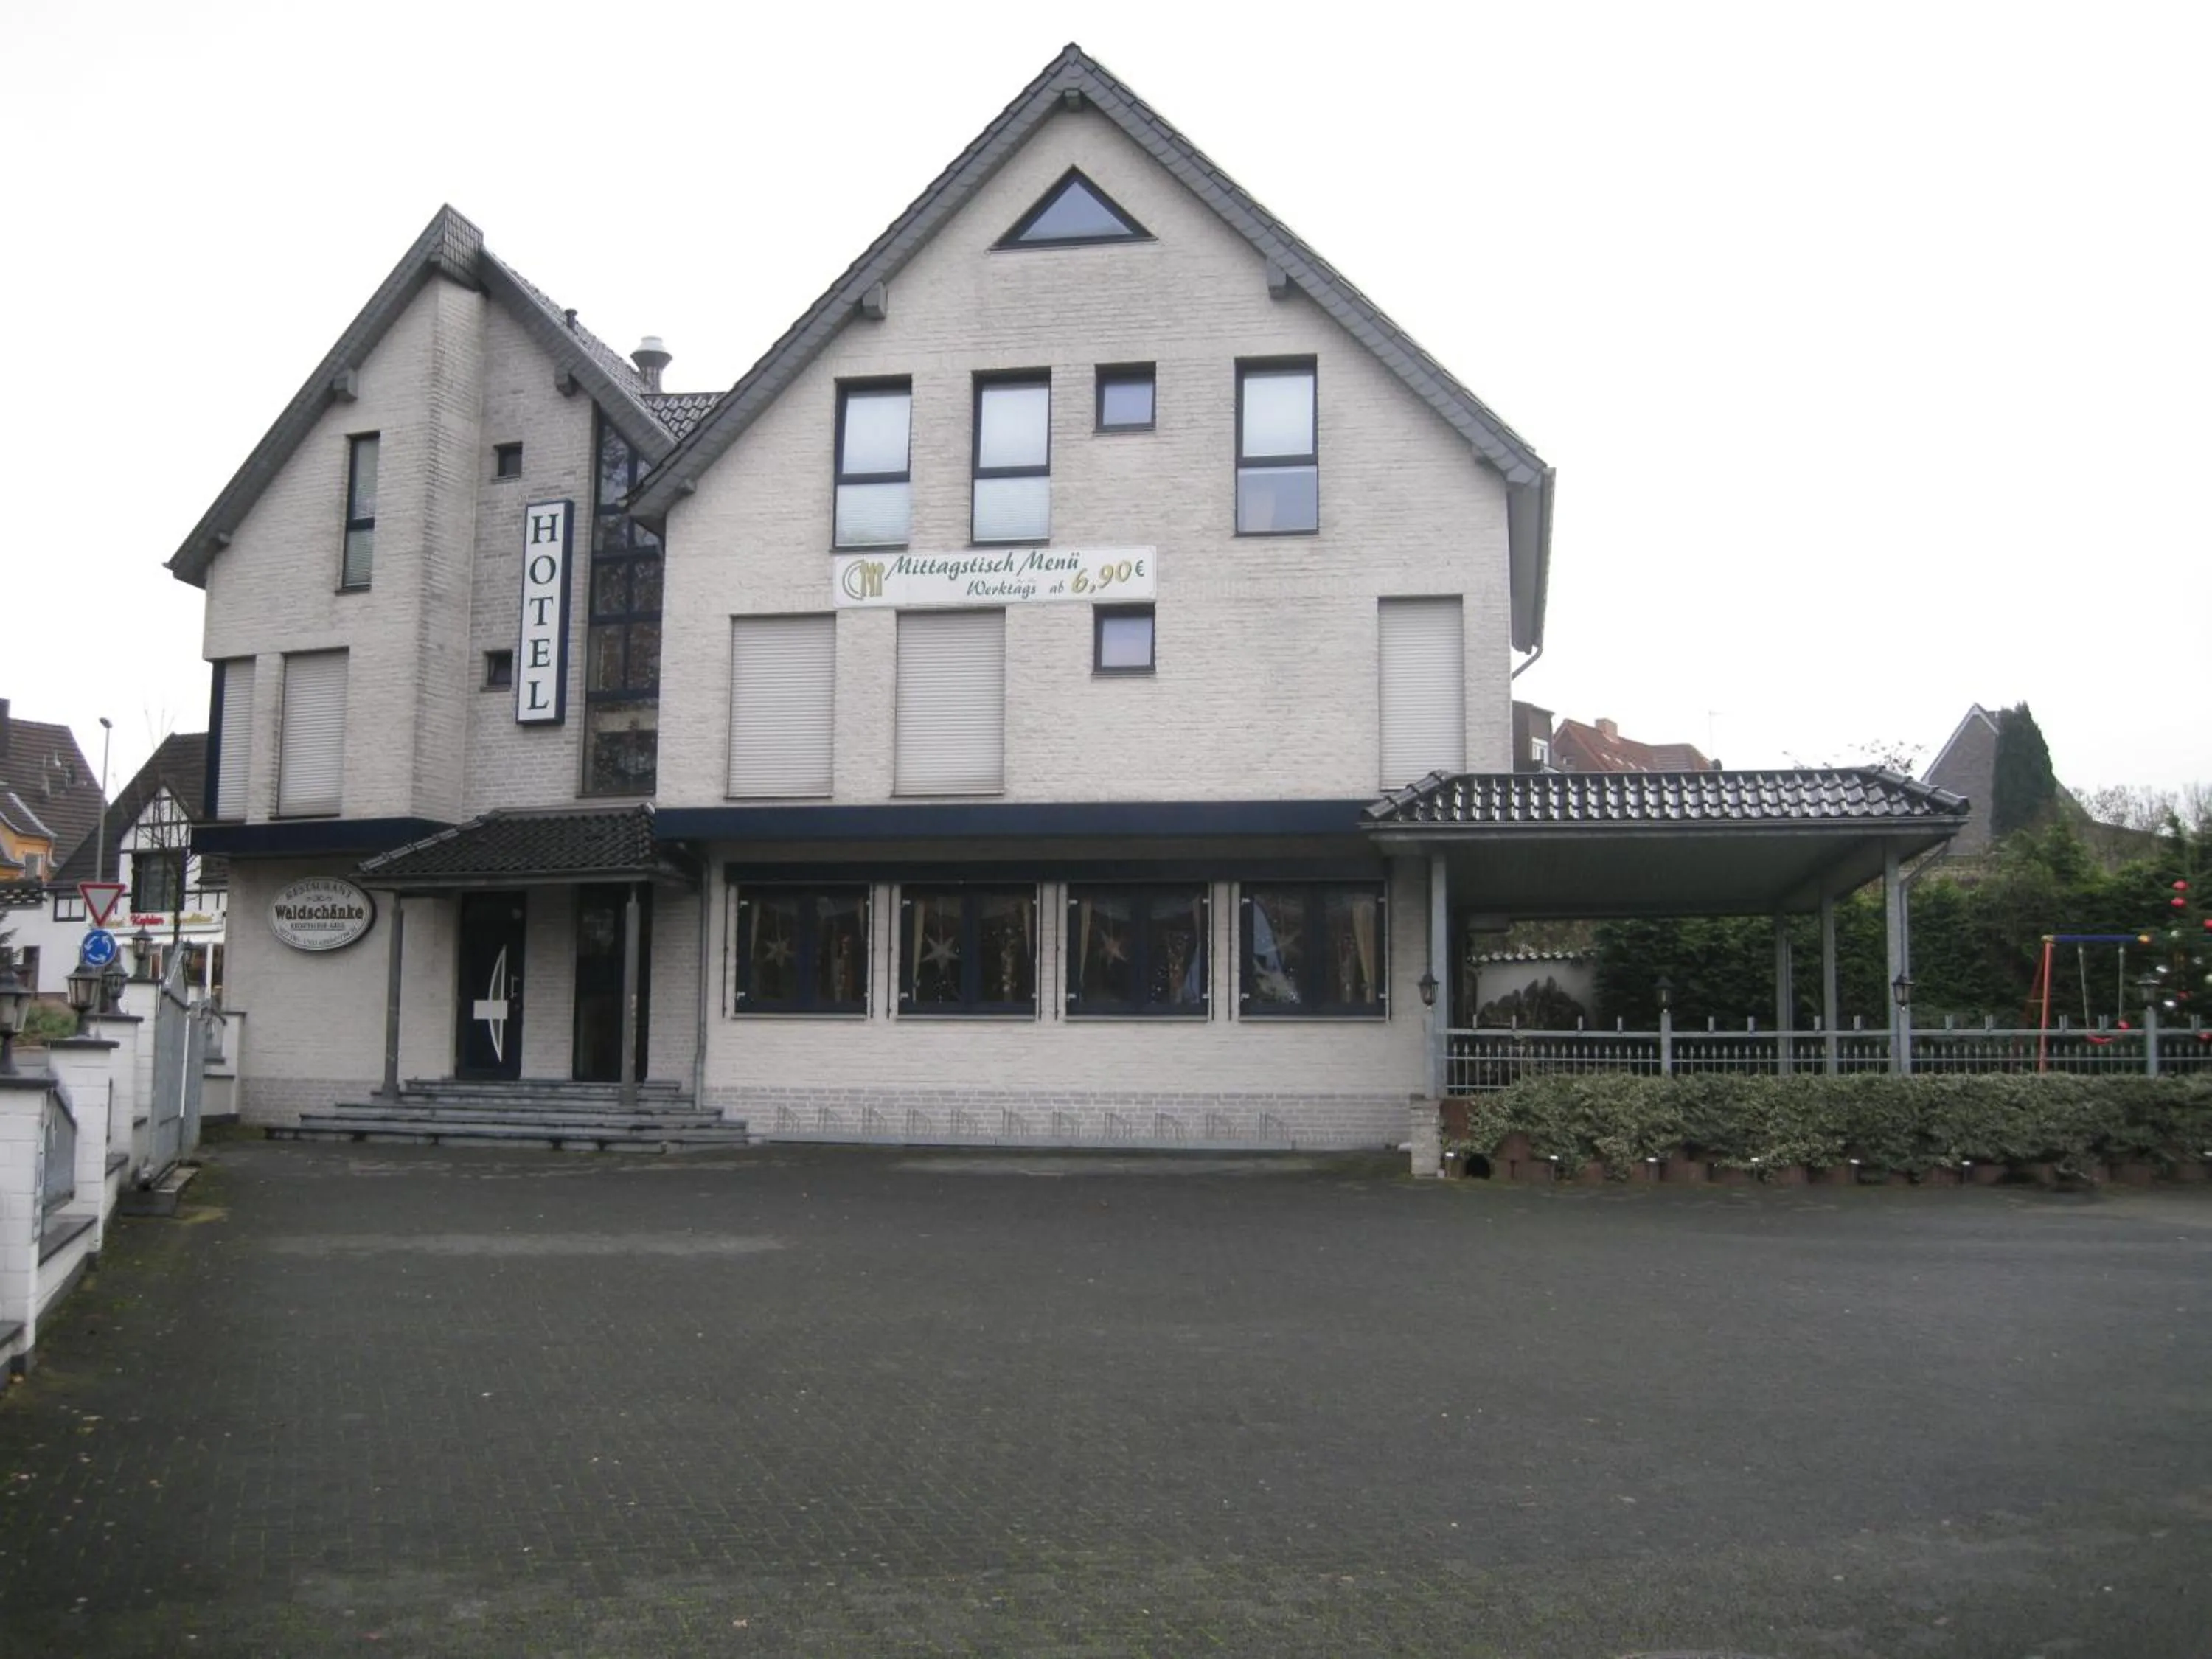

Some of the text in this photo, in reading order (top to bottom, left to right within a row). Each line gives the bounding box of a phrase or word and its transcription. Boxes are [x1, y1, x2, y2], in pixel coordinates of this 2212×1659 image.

[885, 550, 1080, 581] Mittagstisch Menü
[527, 512, 559, 710] HOTEL
[275, 904, 364, 920] Waldschänke
